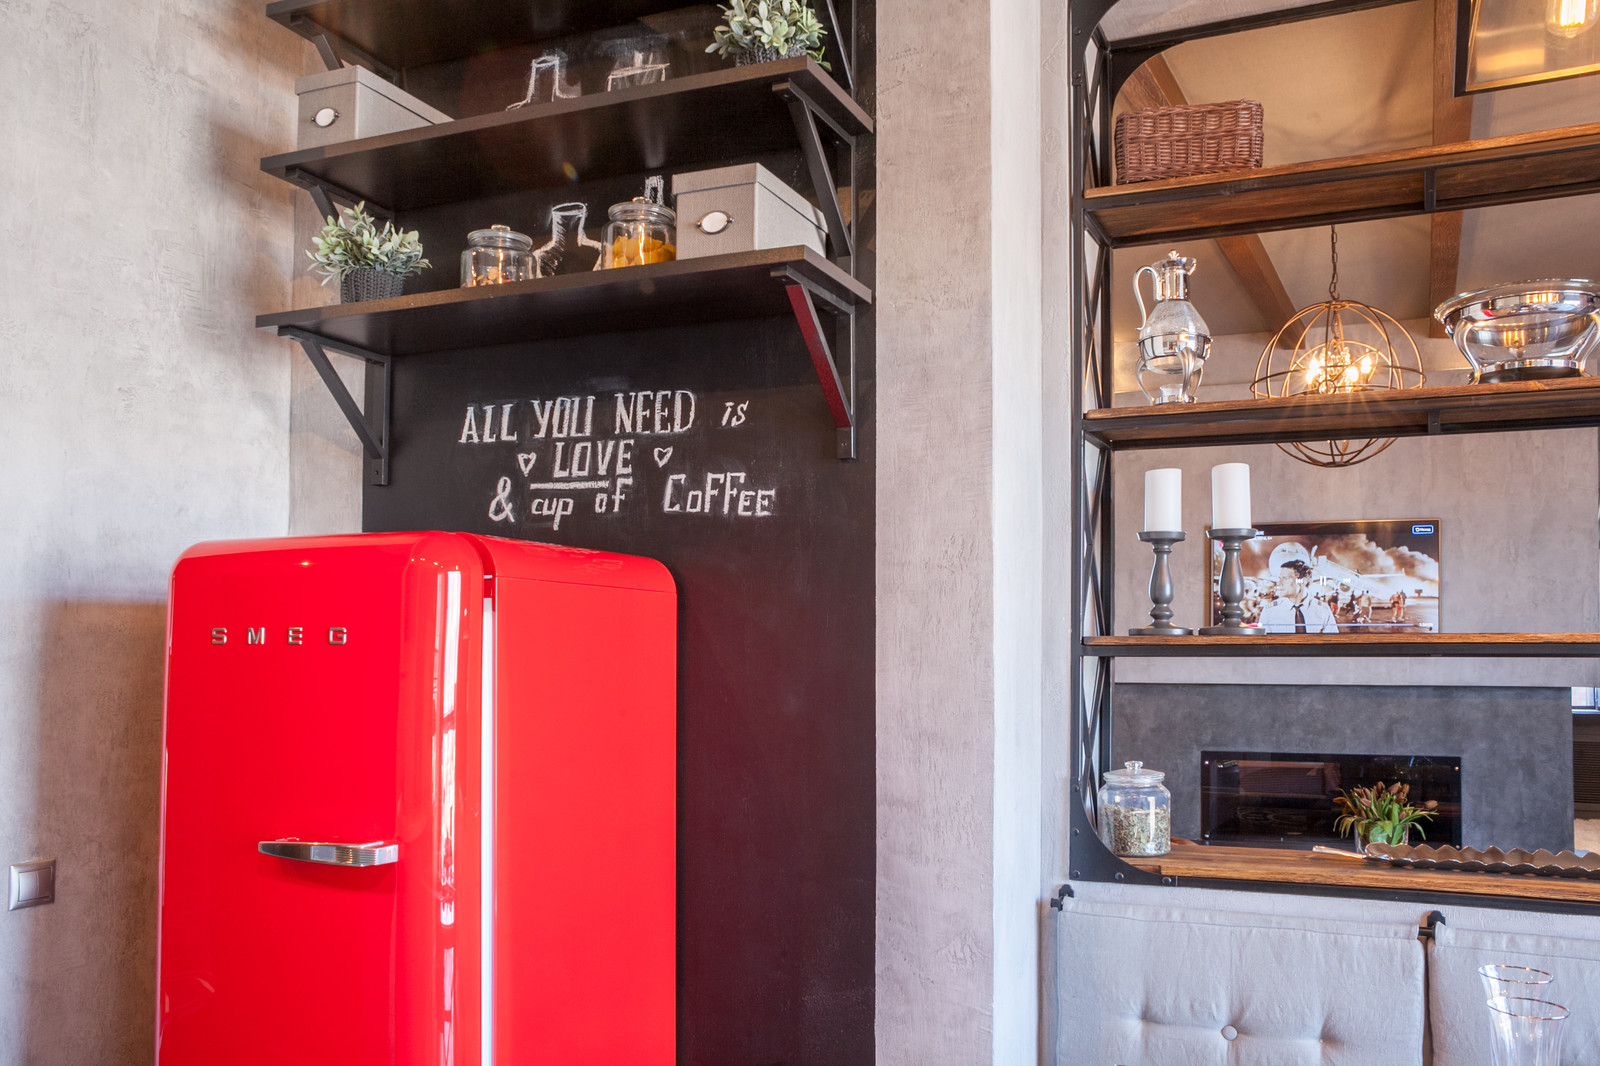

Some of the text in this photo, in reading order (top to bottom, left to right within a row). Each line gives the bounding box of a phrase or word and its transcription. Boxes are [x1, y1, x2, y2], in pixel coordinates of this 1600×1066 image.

[458, 403, 517, 443] ALL
[614, 390, 696, 434] NEED
[553, 439, 635, 478] LOVE
[488, 476, 515, 523] &
[211, 626, 347, 645] SMEG
